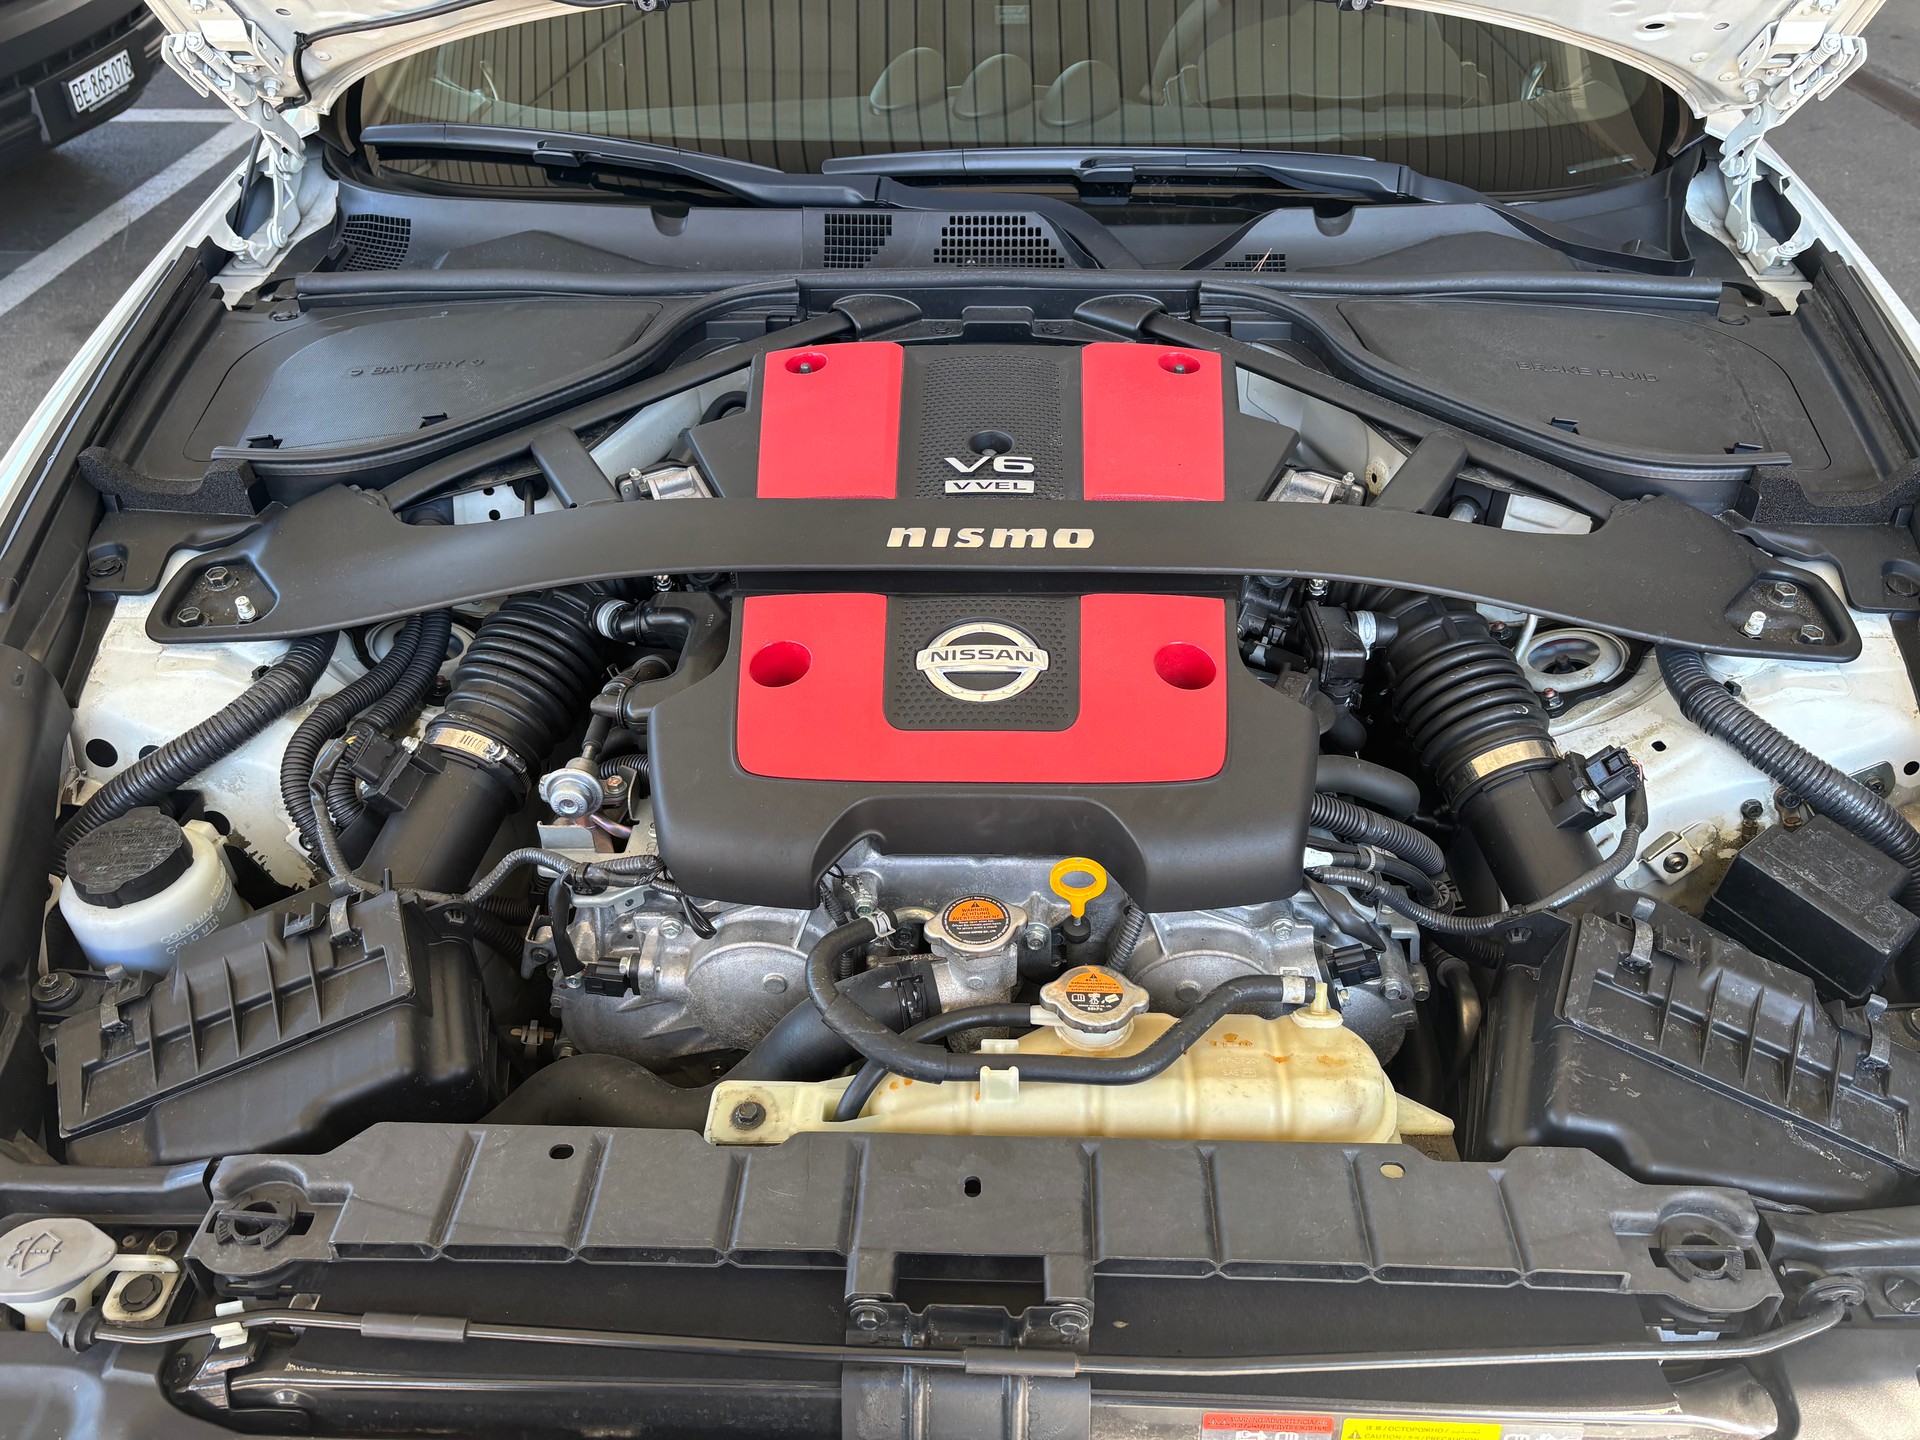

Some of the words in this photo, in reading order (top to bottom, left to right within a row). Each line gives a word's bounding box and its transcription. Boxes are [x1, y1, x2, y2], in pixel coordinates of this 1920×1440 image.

[371, 360, 466, 375] BATTERY
[1516, 361, 1592, 376] BRAKE
[1597, 369, 1660, 382] FLUID
[943, 456, 1035, 473] V6
[953, 481, 1028, 490] VVEL
[886, 527, 1095, 549] nismo
[930, 649, 1035, 663] NISSAN
[160, 923, 195, 944] COLD
